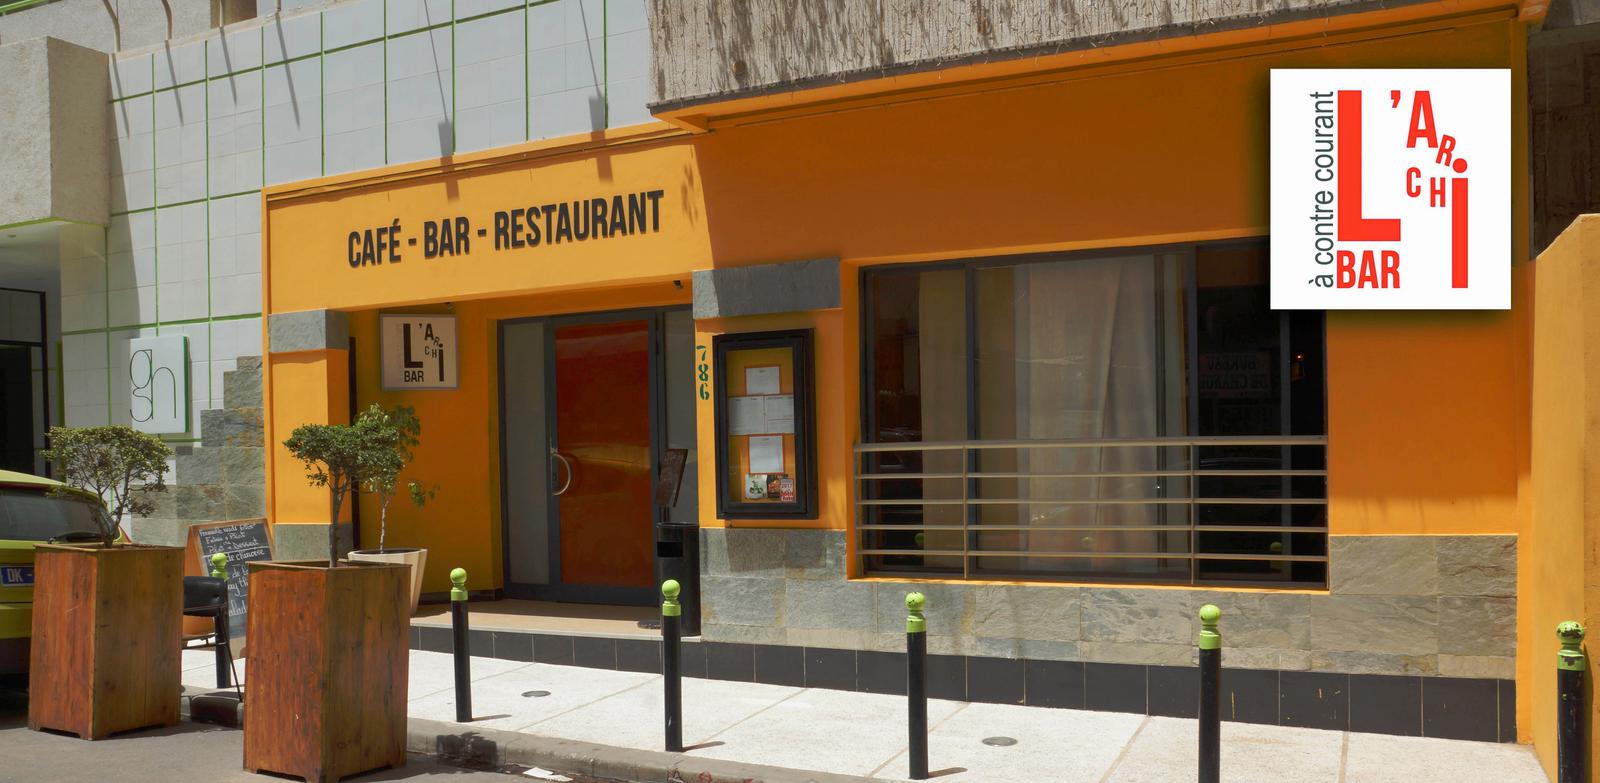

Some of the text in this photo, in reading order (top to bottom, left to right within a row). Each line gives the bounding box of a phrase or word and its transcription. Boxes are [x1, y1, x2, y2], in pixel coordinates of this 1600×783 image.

[347, 218, 402, 268] CAFÉ
[423, 216, 471, 260] BAR
[494, 189, 664, 252] RESTAURANT
[404, 370, 424, 383] BAR
[7, 568, 23, 583] DK
